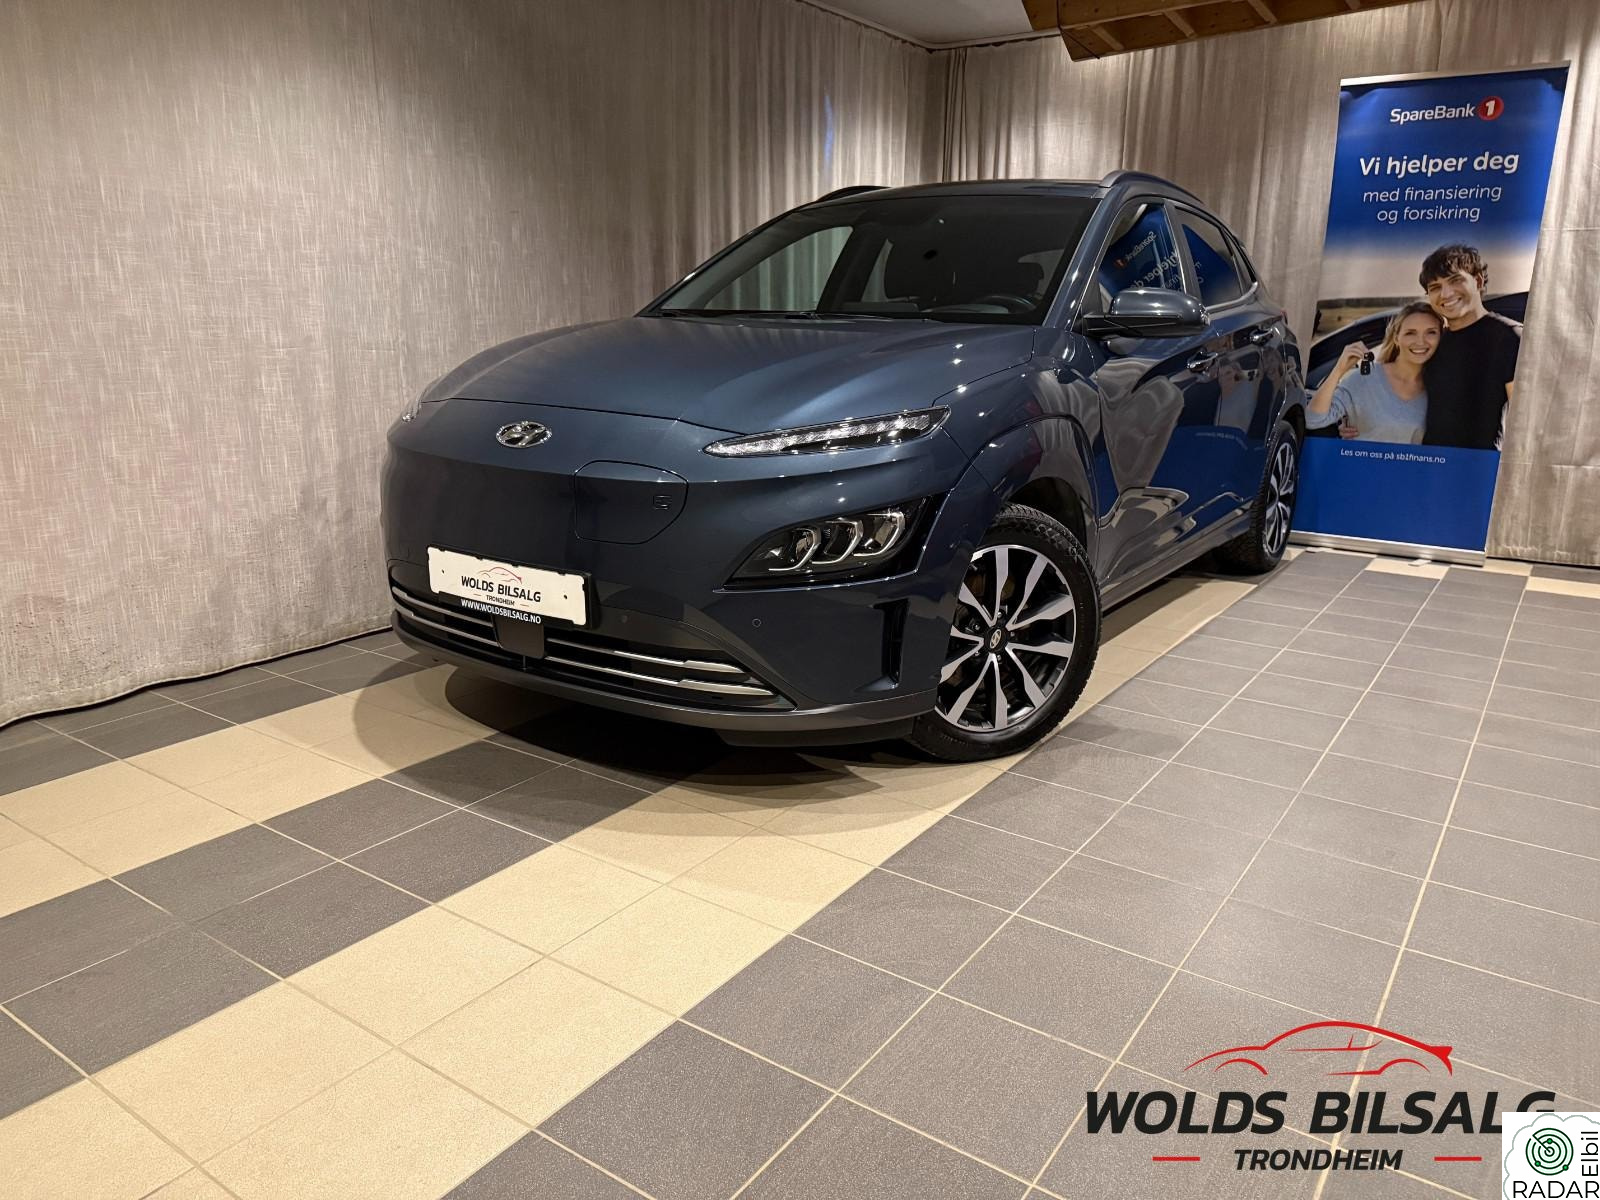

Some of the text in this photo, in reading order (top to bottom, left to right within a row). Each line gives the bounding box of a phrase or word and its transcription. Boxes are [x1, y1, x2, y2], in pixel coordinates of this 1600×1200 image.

[1390, 99, 1496, 125] SpareBank 1
[1359, 151, 1520, 178] Vi hjelper deg
[1363, 184, 1502, 203] med finansiering
[1376, 205, 1480, 224] og forsikring
[1340, 447, 1353, 456] Les
[1354, 449, 1368, 457] om
[1384, 452, 1395, 460] på
[1396, 452, 1446, 463] sb1finans.no
[461, 575, 541, 603] WOLDS BILSALG
[460, 599, 541, 624] WWW.WOLDSBILSALG.NO
